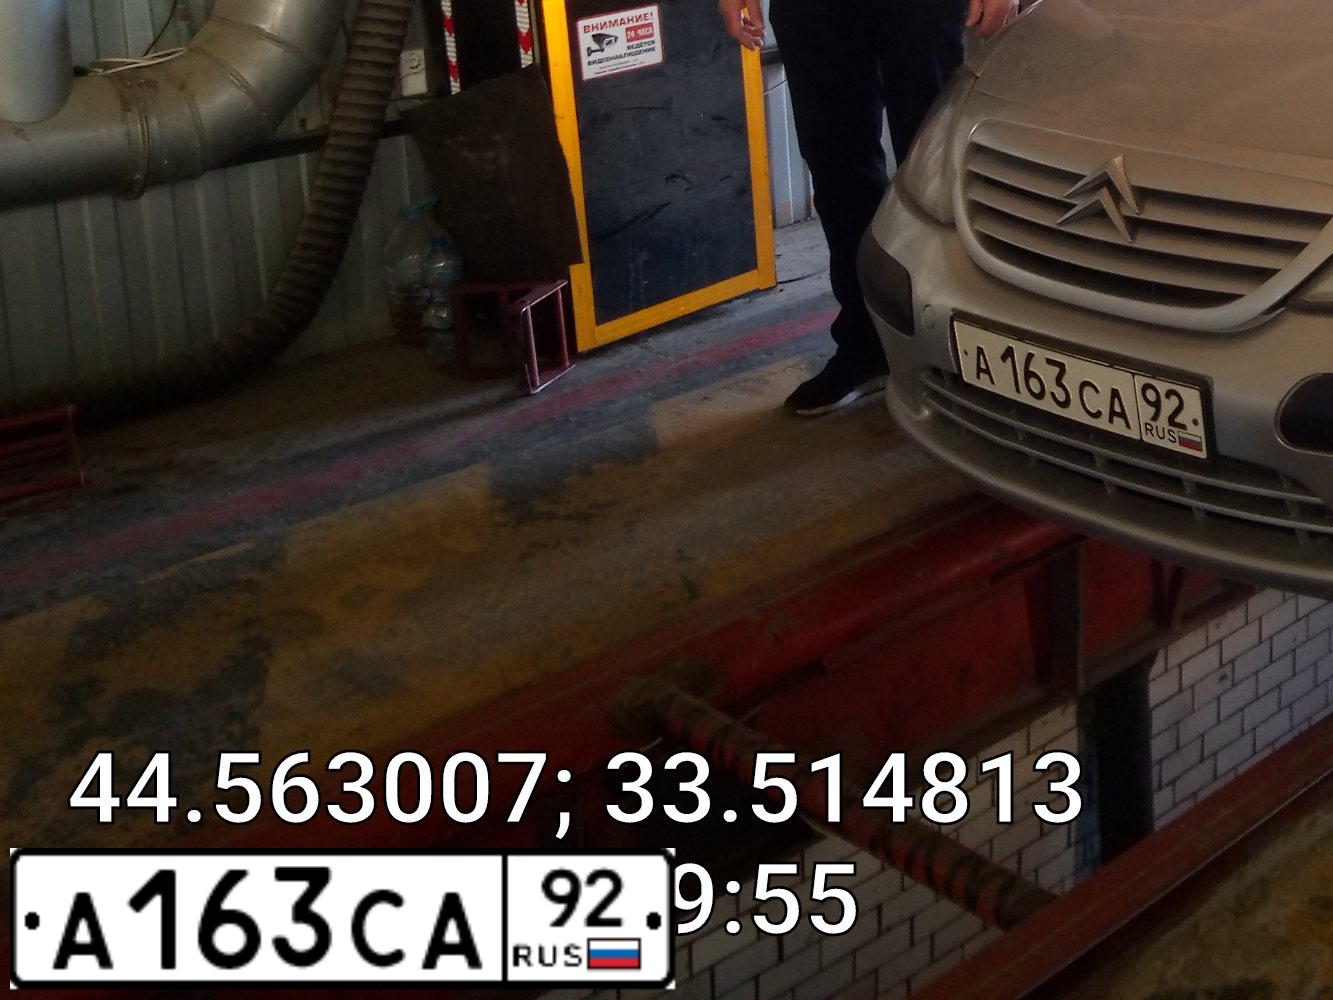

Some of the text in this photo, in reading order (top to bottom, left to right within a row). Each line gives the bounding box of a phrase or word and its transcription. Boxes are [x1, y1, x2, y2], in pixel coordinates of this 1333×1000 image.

[583, 11, 654, 34] ВНИМАНИЕ!
[1140, 382, 1188, 430] 92
[1144, 422, 1178, 444] RUS
